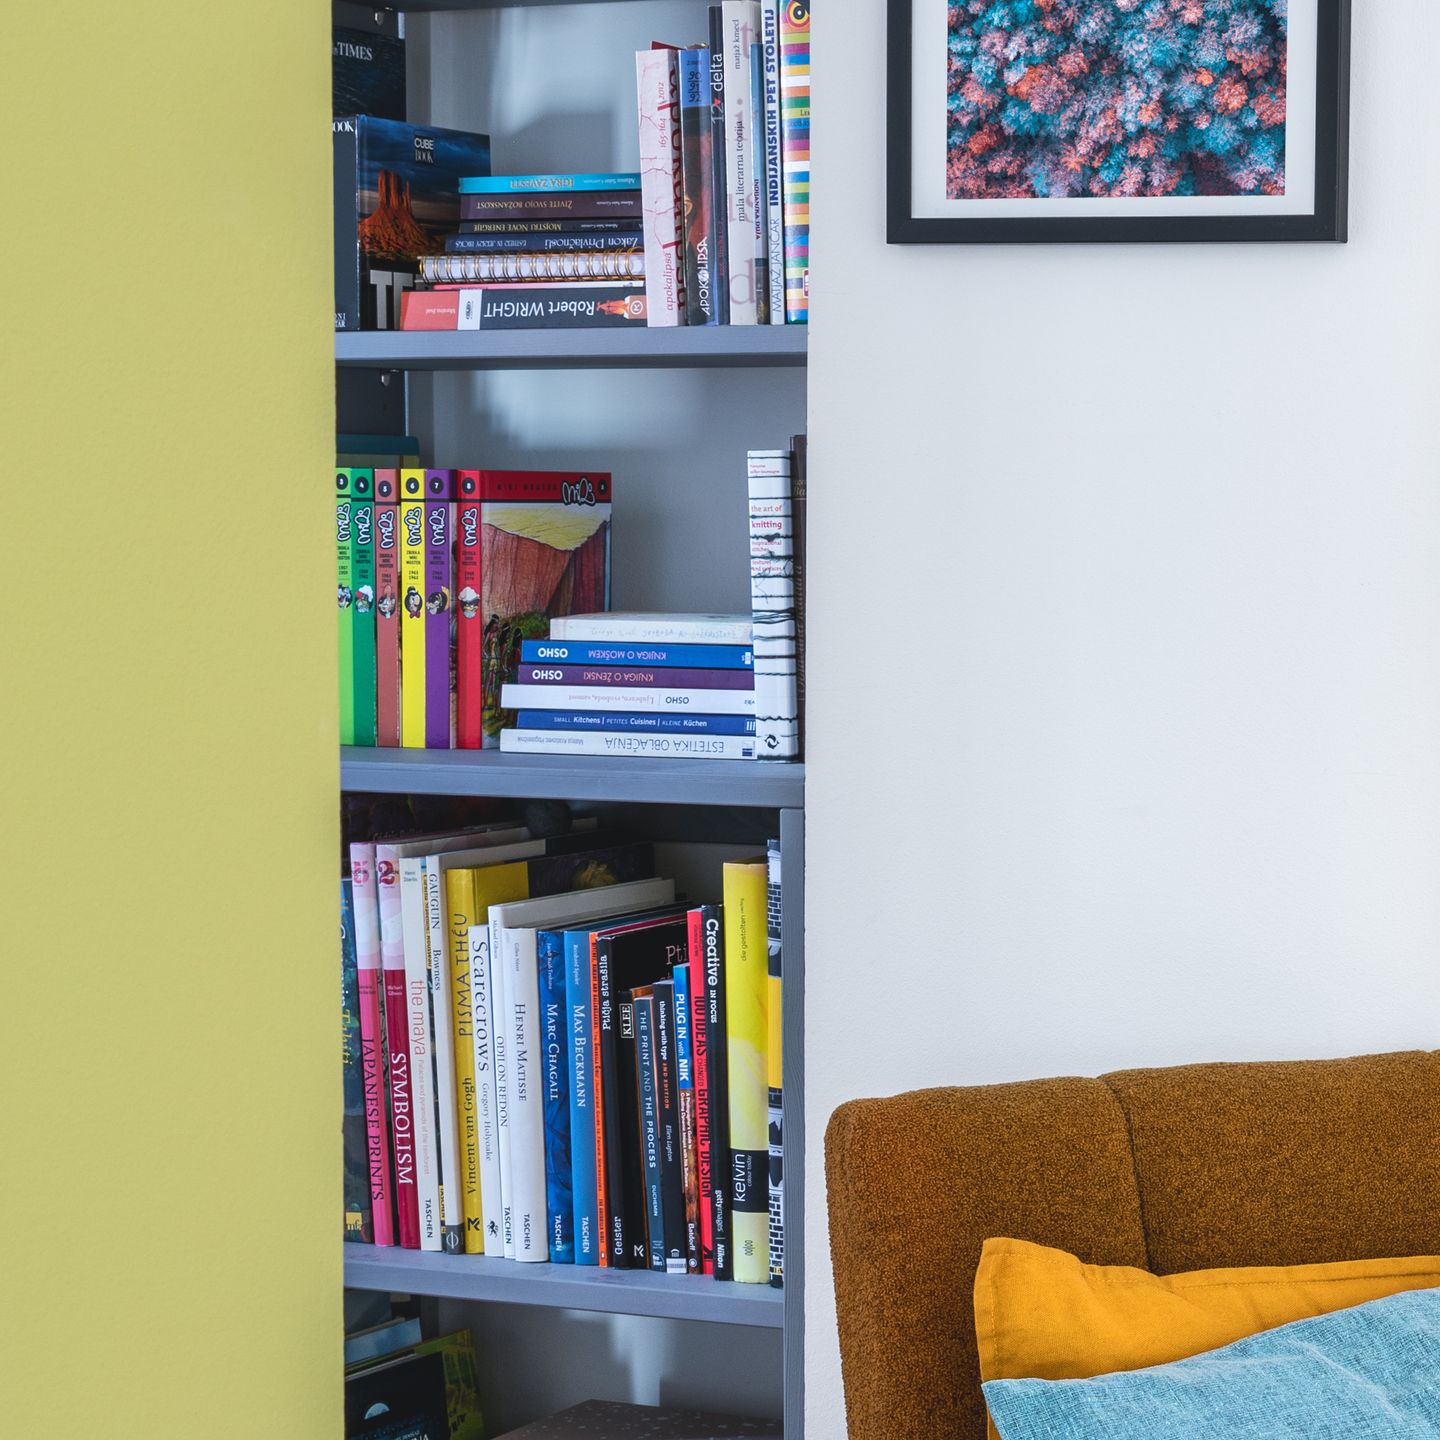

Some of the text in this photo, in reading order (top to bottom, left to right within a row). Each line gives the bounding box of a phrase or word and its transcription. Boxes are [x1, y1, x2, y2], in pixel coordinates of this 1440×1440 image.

[765, 9, 779, 207] INDIJANSKIH PET STOLETIJ
[483, 299, 595, 319] Robert WRIGHT
[751, 519, 783, 531] knitting
[537, 646, 569, 659] OSHO
[705, 918, 719, 986] Creative
[471, 940, 489, 1072] Scarecrows
[622, 1005, 631, 1036] KLEE
[390, 1052, 414, 1185] SYMBOLISM
[732, 1152, 746, 1203] kelvin
